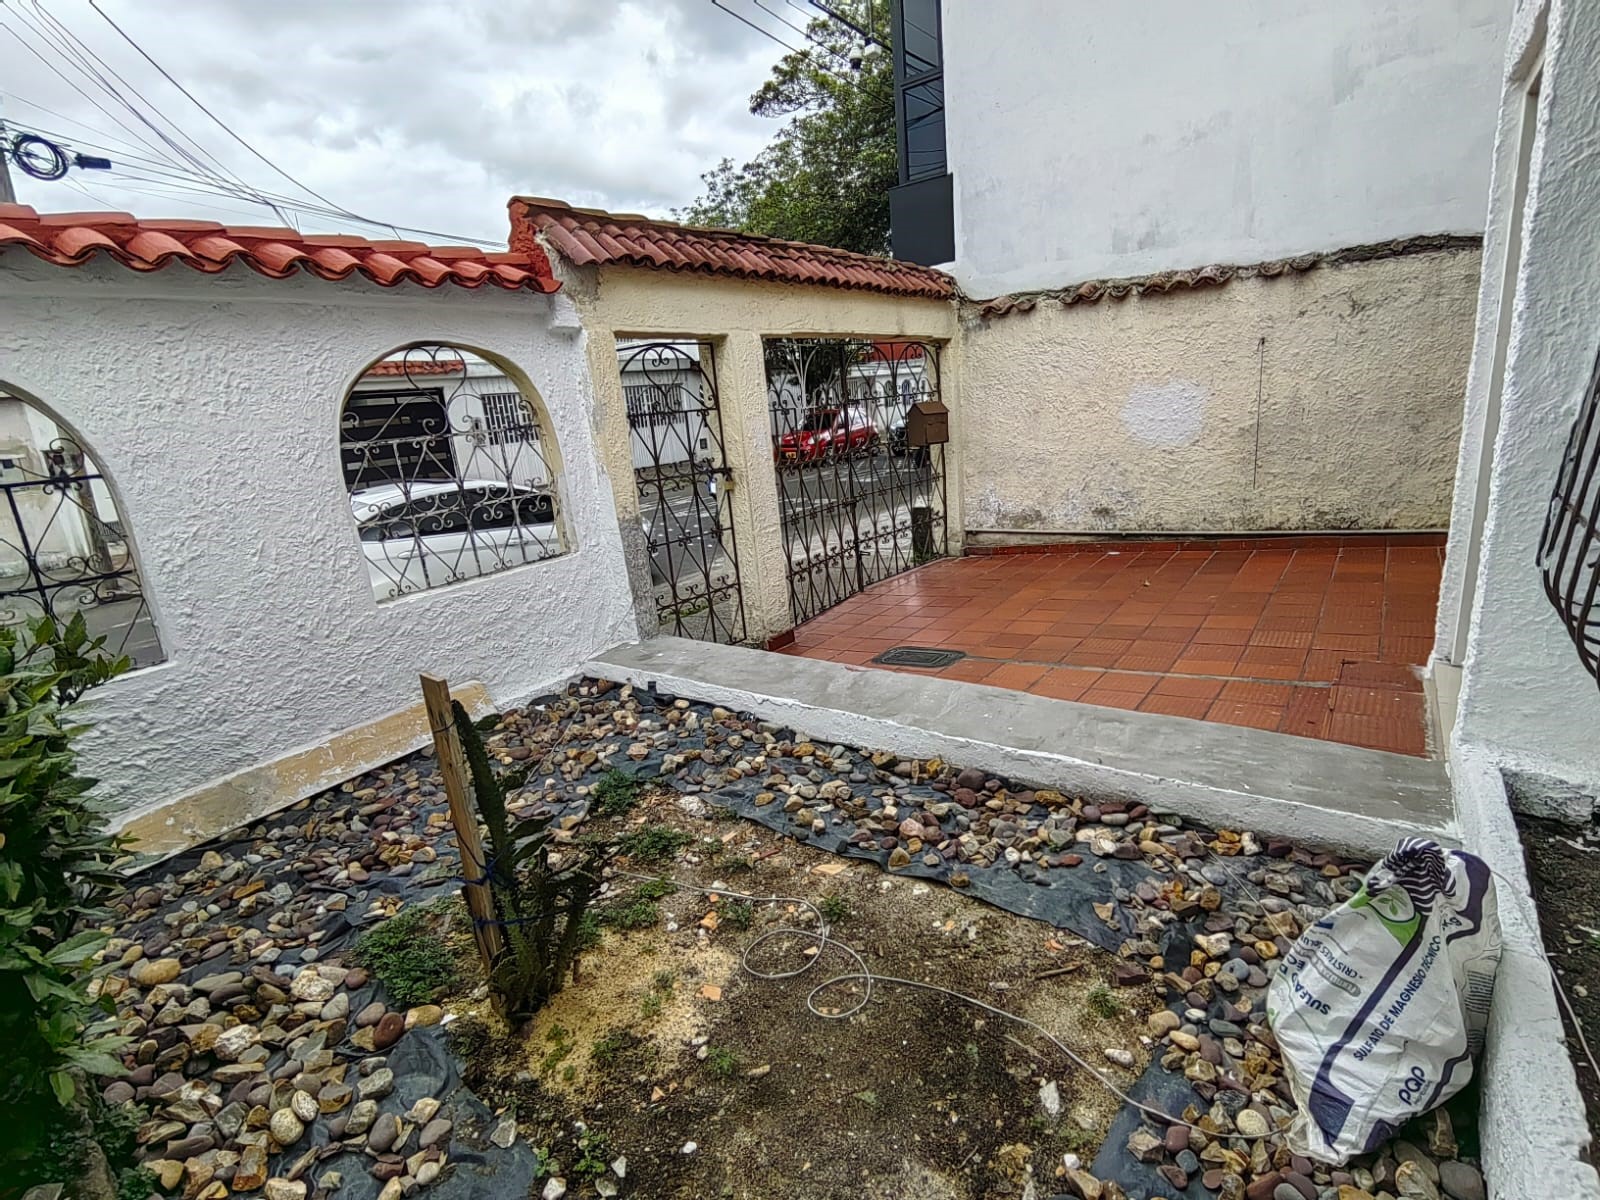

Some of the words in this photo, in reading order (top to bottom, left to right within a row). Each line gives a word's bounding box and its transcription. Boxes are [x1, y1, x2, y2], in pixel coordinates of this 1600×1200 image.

[1353, 1028, 1384, 1061] SULFATO
[1379, 1015, 1394, 1031] DE
[1388, 969, 1426, 1018] MAGNESIO
[1398, 1066, 1425, 1106] PQP
